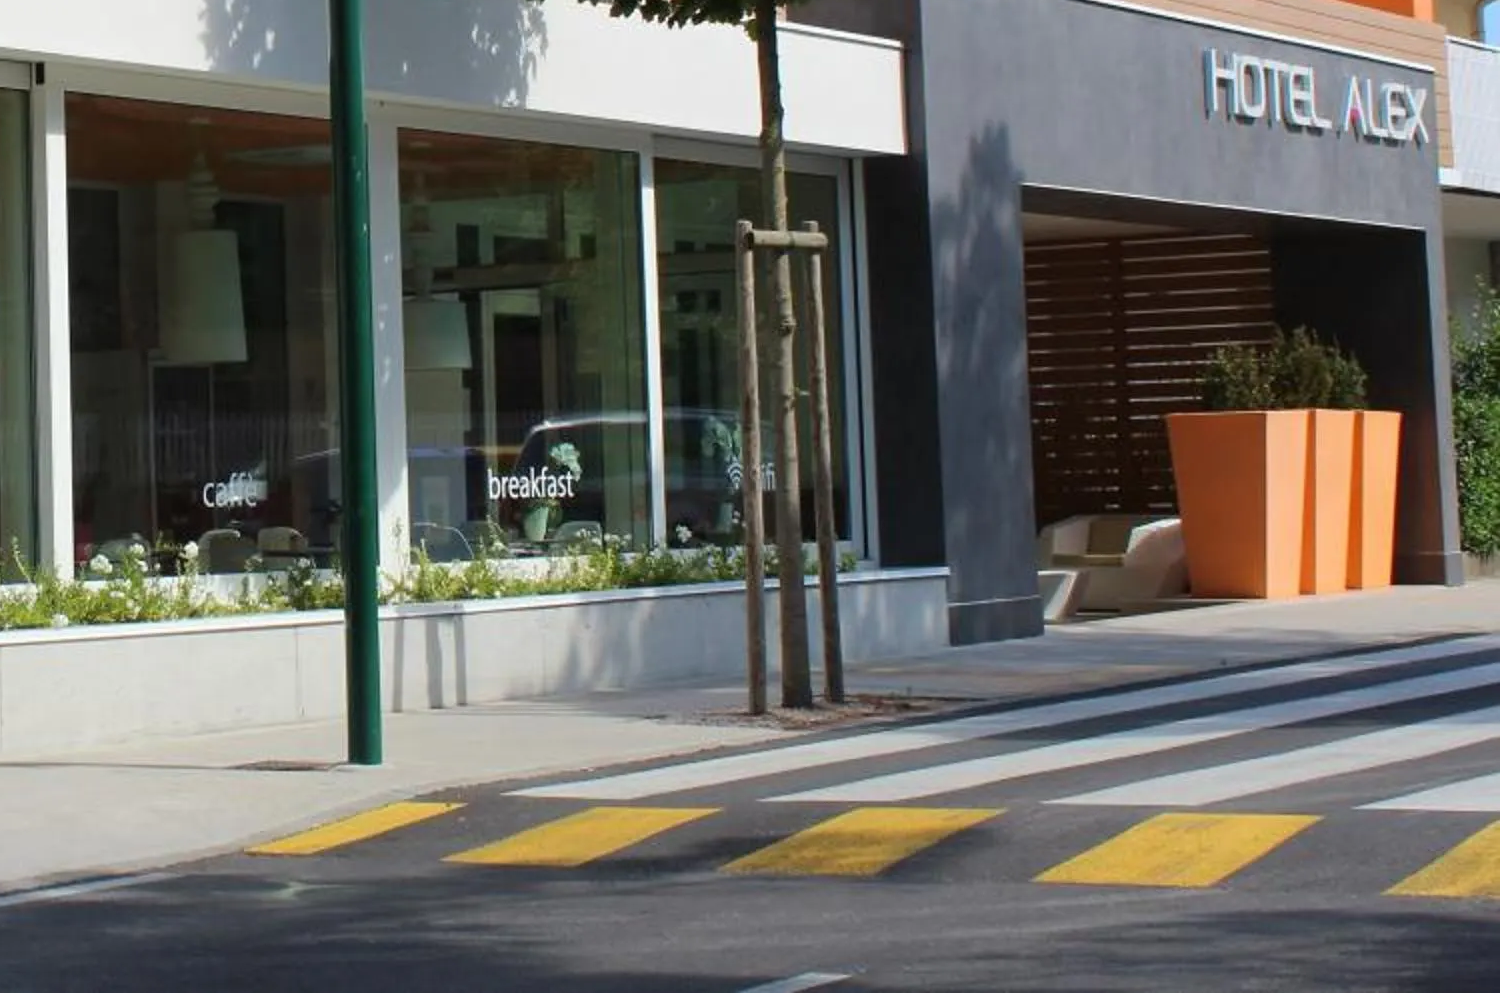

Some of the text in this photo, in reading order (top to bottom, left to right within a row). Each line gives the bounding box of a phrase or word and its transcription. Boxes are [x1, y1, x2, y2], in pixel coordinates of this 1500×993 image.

[1202, 47, 1430, 144] HOTEL ALEX
[487, 467, 575, 500] breakfast
